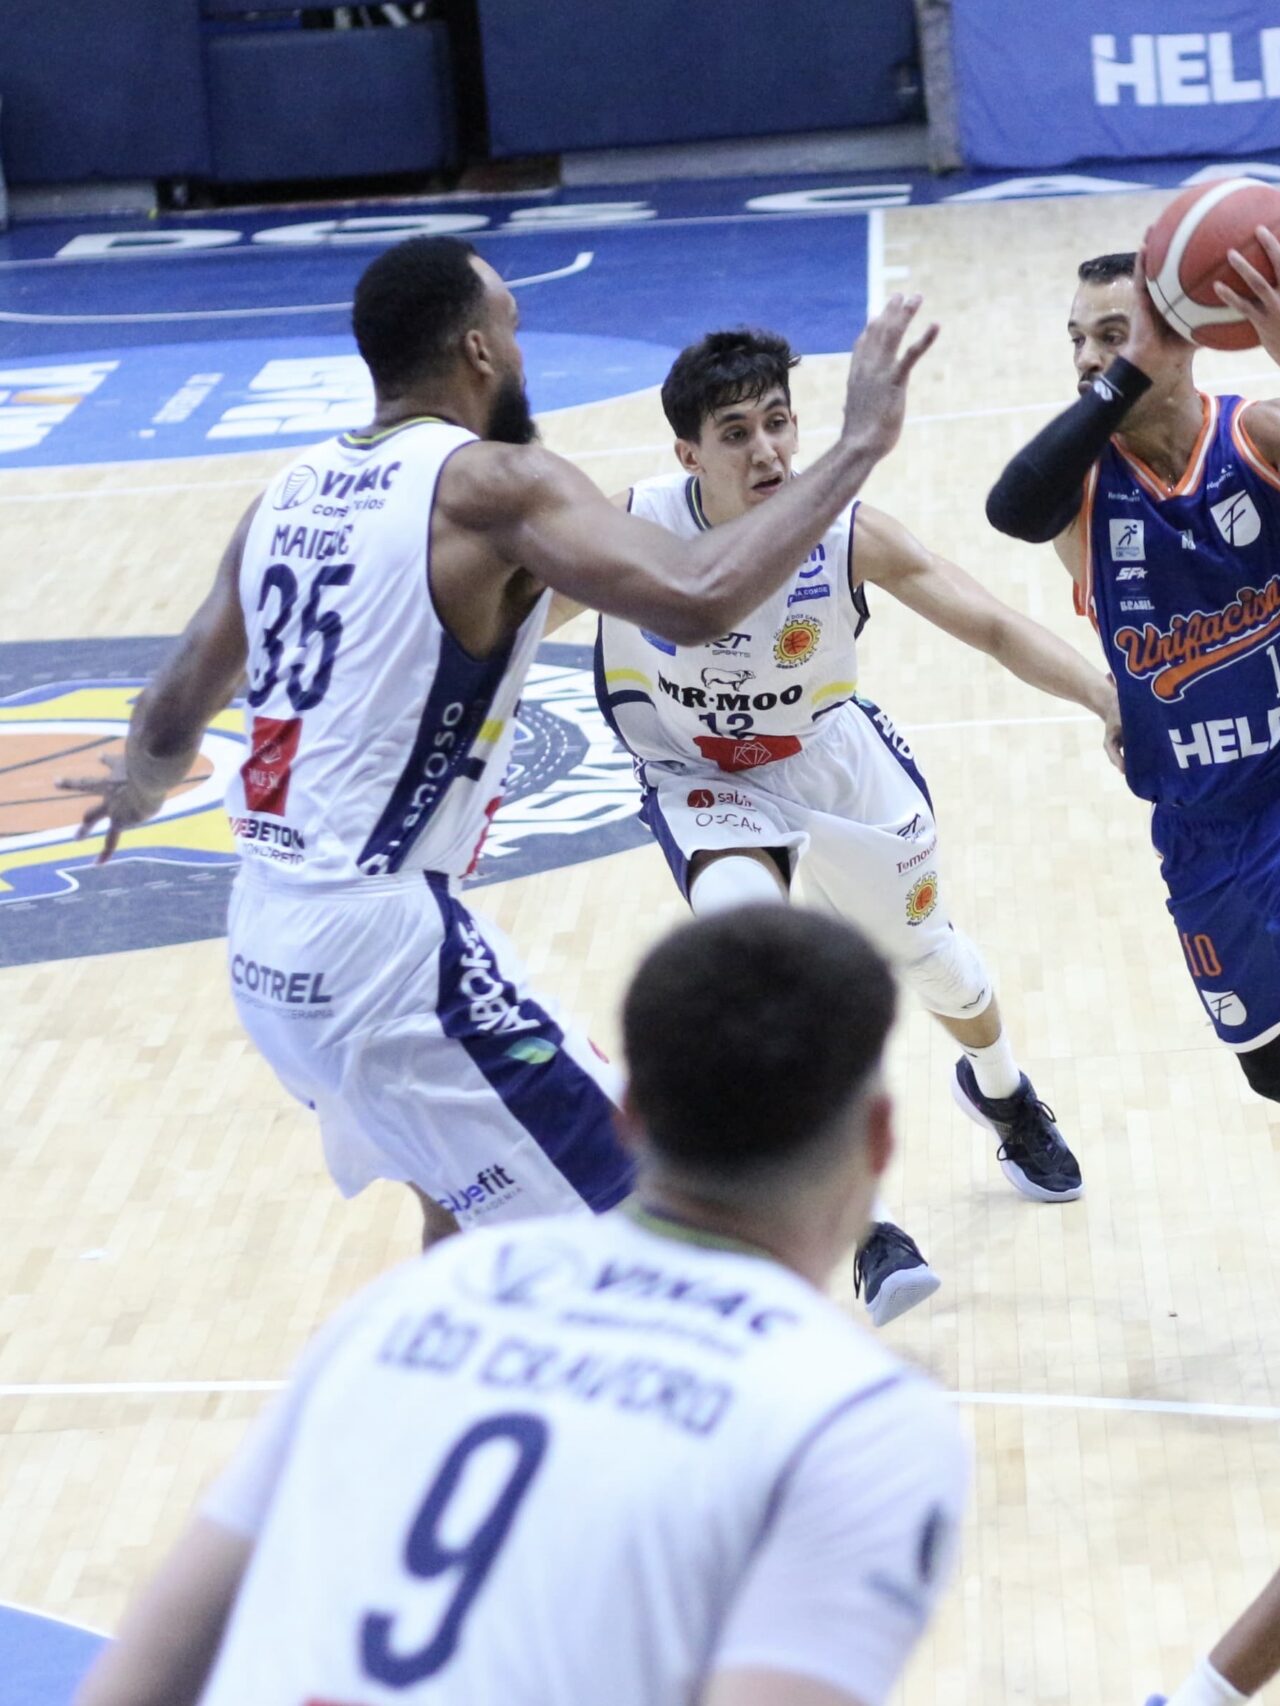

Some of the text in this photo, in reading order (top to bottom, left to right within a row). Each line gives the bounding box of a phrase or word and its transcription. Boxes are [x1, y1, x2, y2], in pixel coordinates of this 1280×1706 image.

[248, 563, 356, 712] 35
[698, 712, 754, 740] 12
[231, 953, 333, 1004] COTREL
[1182, 932, 1222, 977] 10
[357, 1410, 552, 1690] 9
